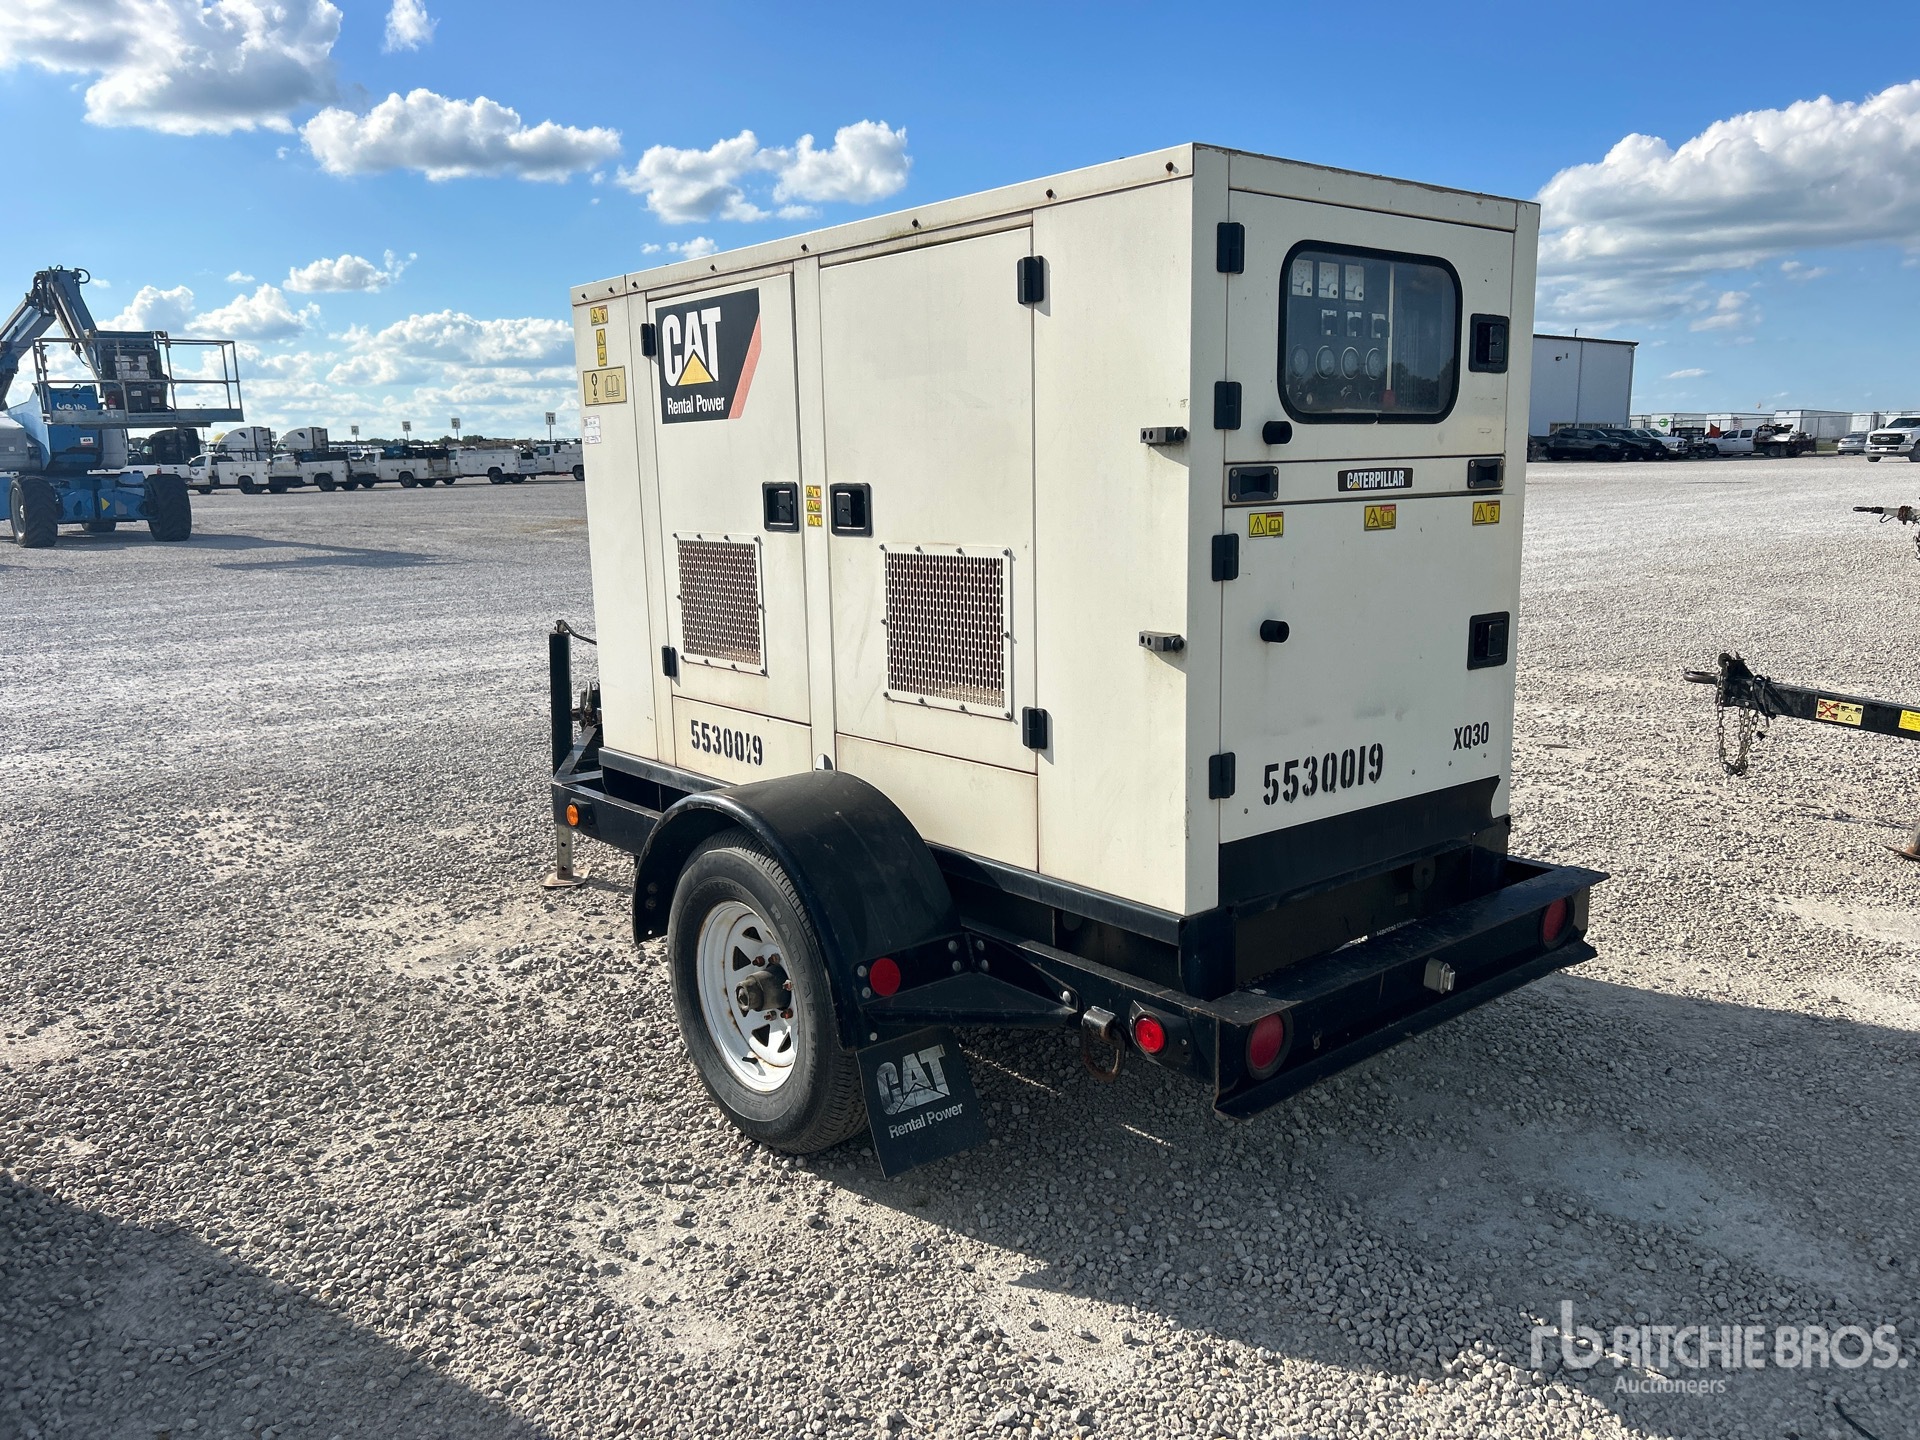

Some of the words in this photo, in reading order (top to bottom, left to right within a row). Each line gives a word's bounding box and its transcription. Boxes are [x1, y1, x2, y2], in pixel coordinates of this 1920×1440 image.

[662, 306, 721, 387] CAT
[667, 395, 694, 415] Rental
[696, 394, 725, 412] Power
[1347, 470, 1405, 489] CATERPILLAR
[690, 719, 763, 766] 5530019
[1453, 721, 1489, 751] XQ30
[1263, 743, 1383, 806] 5530019
[877, 1044, 950, 1115] CAT
[888, 1114, 926, 1139] Rental
[926, 1103, 963, 1125] Power
